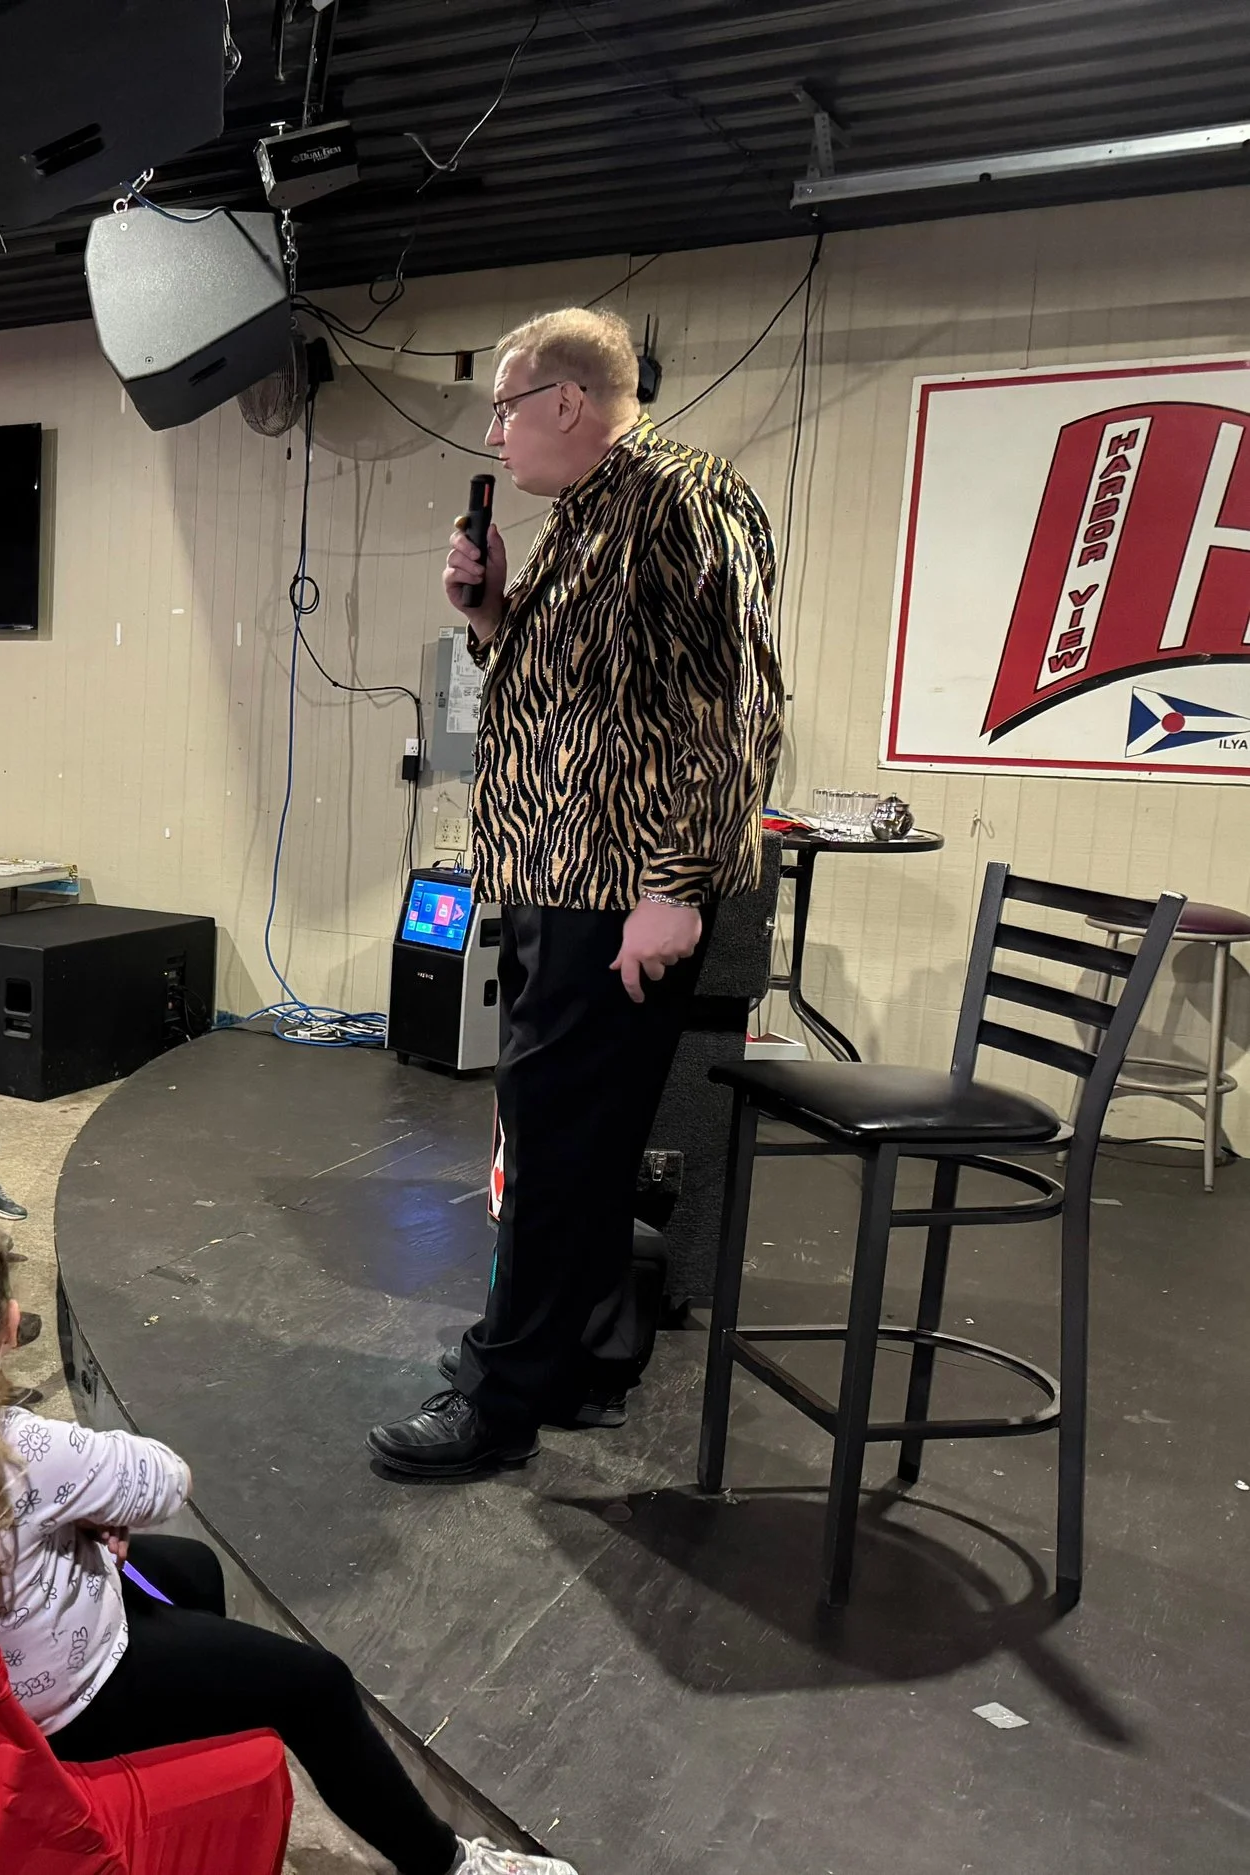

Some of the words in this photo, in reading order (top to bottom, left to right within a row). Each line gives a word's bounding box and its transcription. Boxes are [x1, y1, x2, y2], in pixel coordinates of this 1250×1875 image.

[1076, 428, 1140, 568] HARBOR
[1048, 584, 1100, 675] VIEW
[1218, 739, 1248, 750] ILYA
